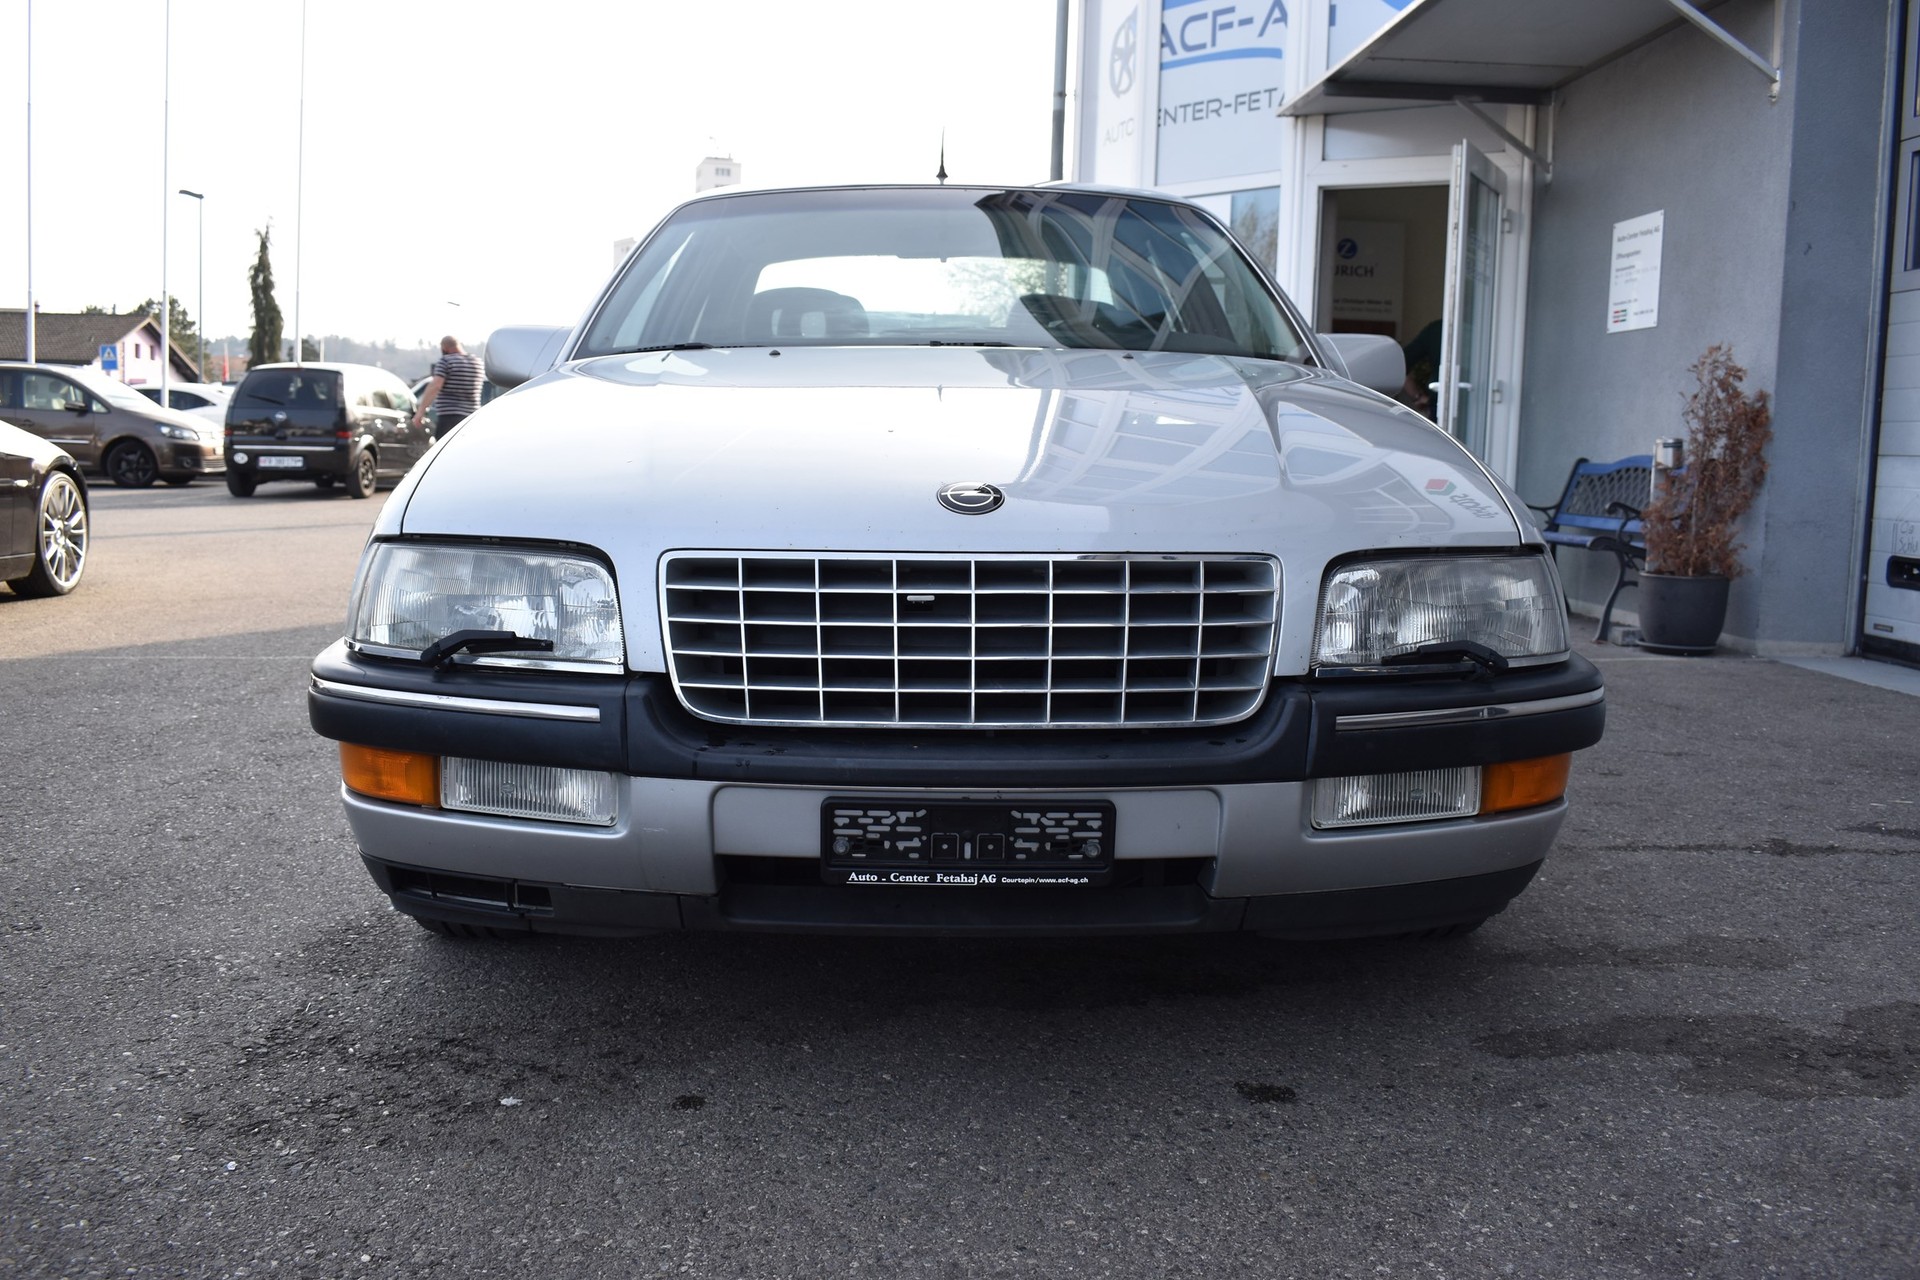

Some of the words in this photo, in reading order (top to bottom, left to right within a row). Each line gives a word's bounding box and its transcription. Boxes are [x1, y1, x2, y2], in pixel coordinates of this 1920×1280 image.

[848, 872, 878, 882] Auto
[889, 872, 930, 882] Center
[936, 873, 978, 886] Fetahaj
[980, 874, 997, 884] AG
